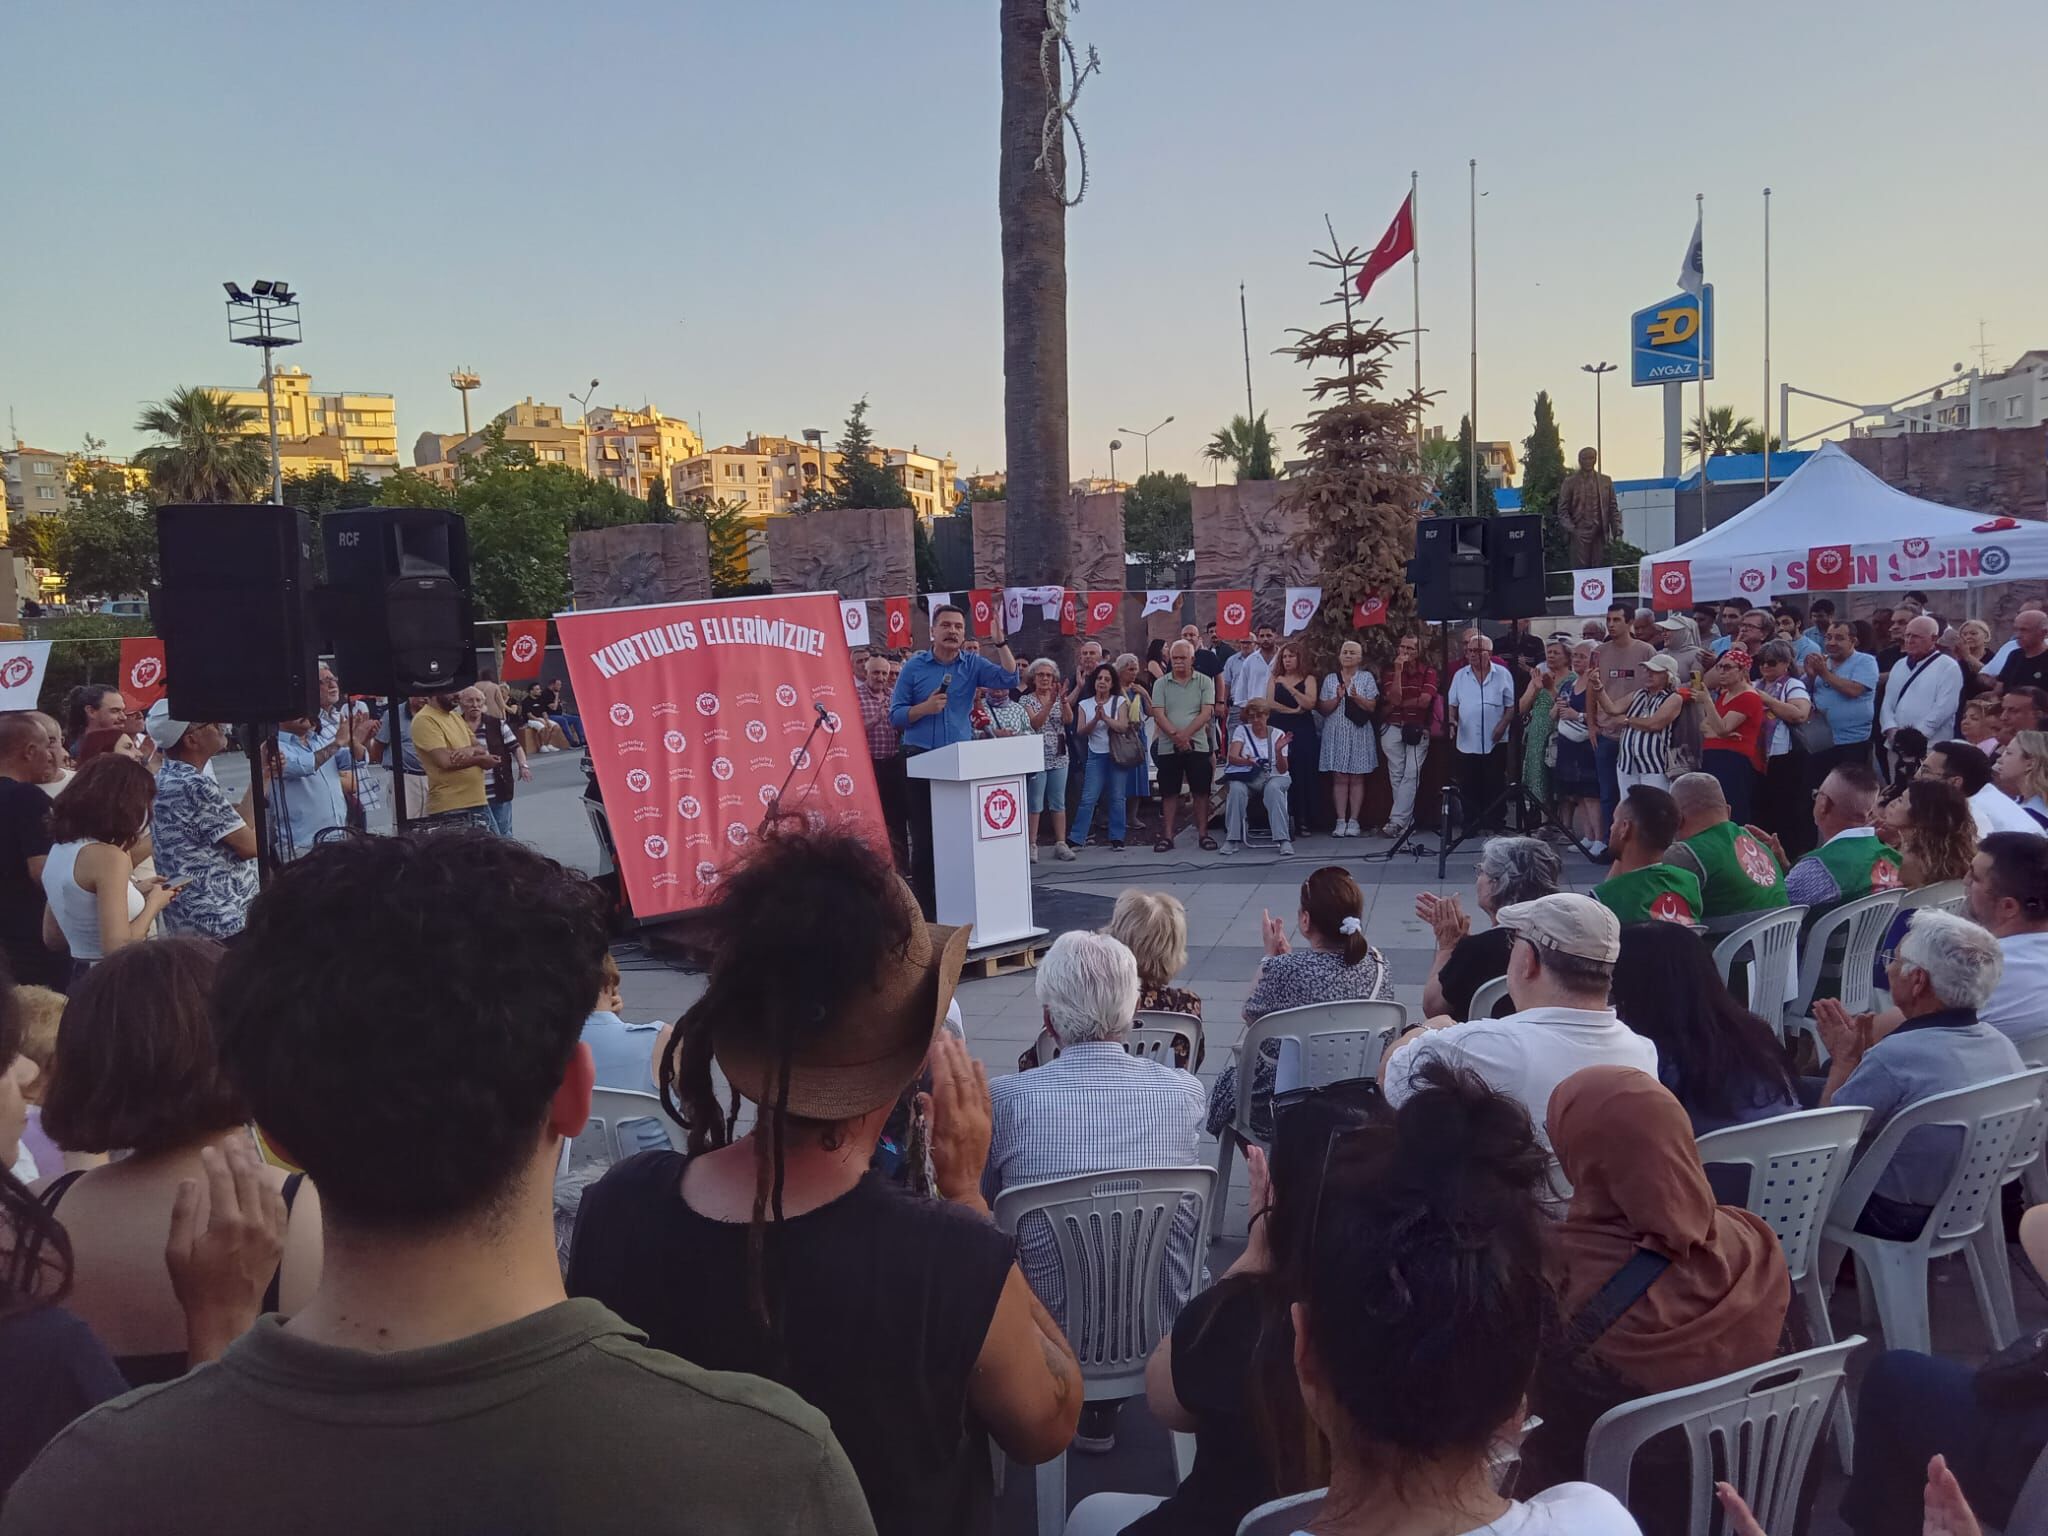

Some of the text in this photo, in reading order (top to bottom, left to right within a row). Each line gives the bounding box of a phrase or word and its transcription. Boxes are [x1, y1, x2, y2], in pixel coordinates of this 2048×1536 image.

[1649, 364, 1692, 377] AYGAZ
[339, 532, 360, 547] RCF
[1509, 530, 1525, 539] RCF
[590, 615, 825, 679] KURTULUŞ ELLERİMİZDE!
[992, 797, 1008, 811] TİP
